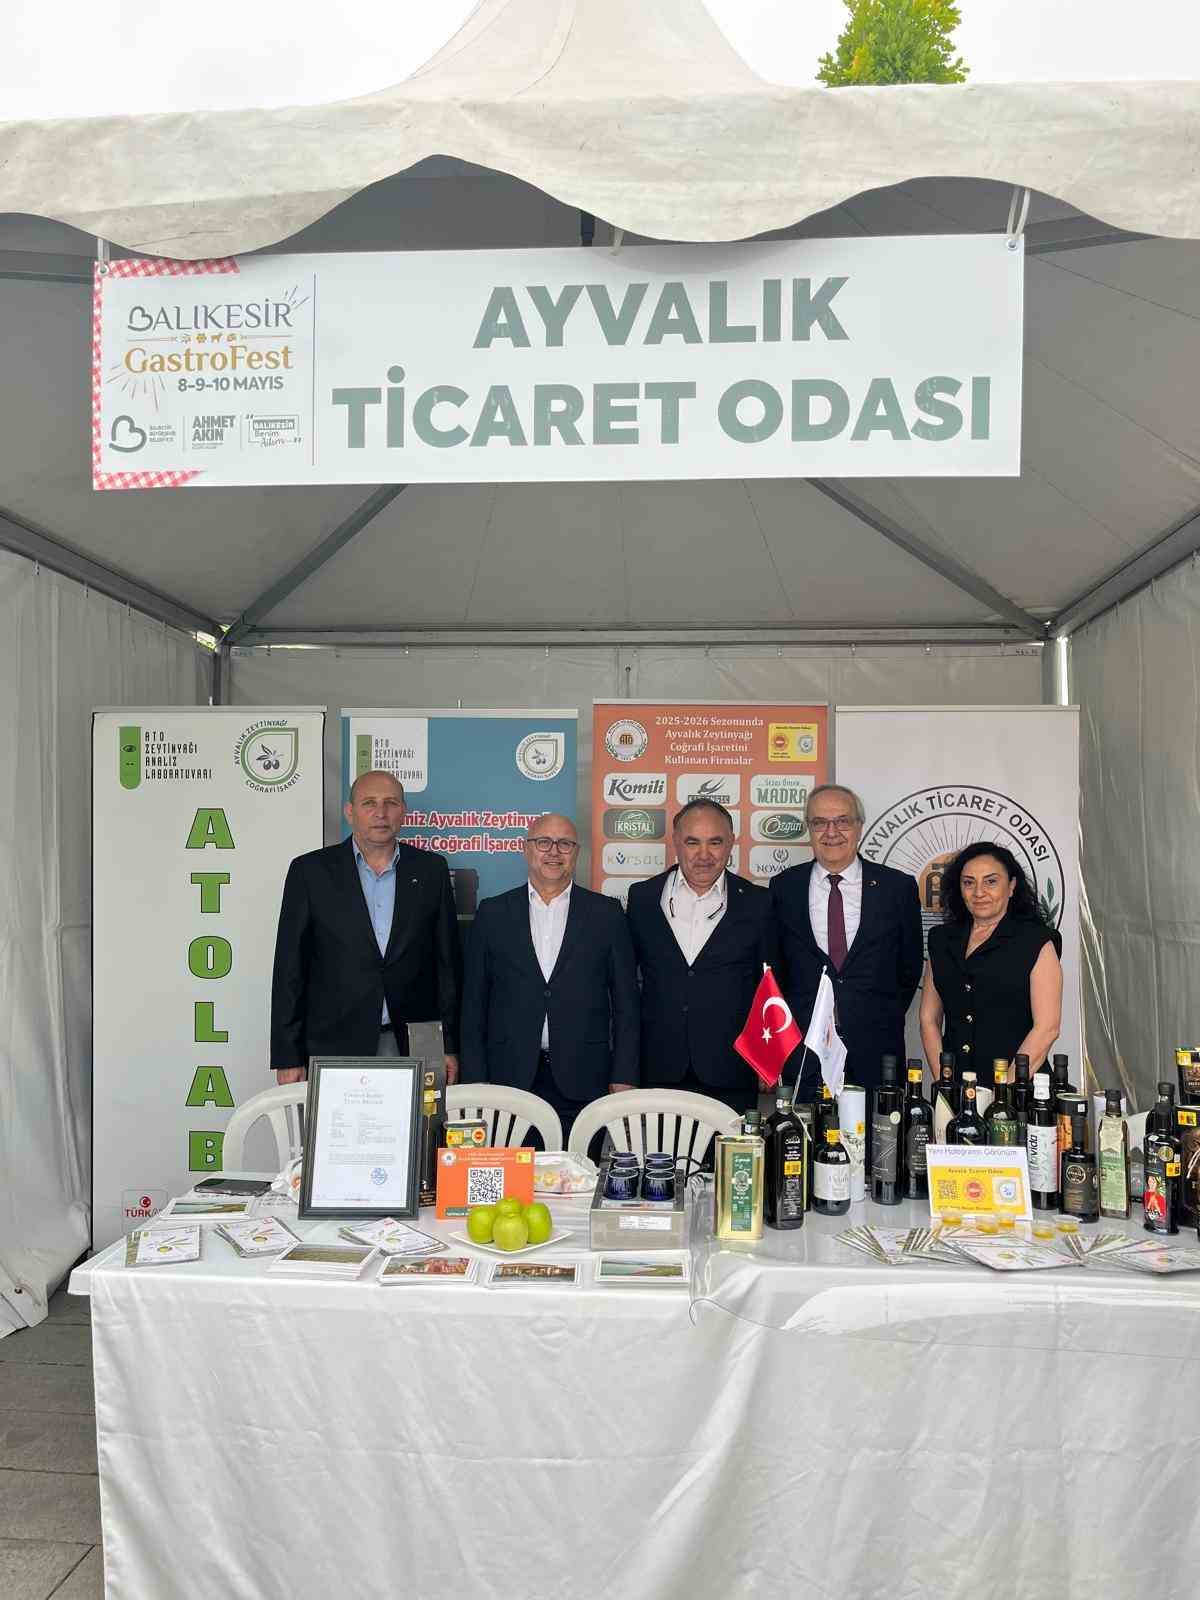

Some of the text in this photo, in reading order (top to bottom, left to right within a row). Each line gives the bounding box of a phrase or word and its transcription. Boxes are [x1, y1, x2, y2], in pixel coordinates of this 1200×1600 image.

[473, 276, 850, 349] AYVALIK
[124, 345, 294, 374] GastroFest
[177, 376, 284, 392] 8-9-10 MAYIS
[332, 365, 992, 449] TİCARET ODASI
[192, 415, 236, 429] AHMET
[655, 716, 708, 727] 2025-2026
[145, 731, 165, 742] ATO
[145, 742, 198, 754] ZEYTİNYAĞI
[664, 754, 754, 766] Kullanan Firmalar
[145, 768, 212, 780] LABORATUVARI
[608, 778, 665, 802] Komili
[756, 788, 807, 804] MADRA
[428, 812, 480, 829] Ayvalık
[864, 791, 1050, 862] AYVALIK TİCARET ODASI
[431, 836, 481, 852] Coğrafi
